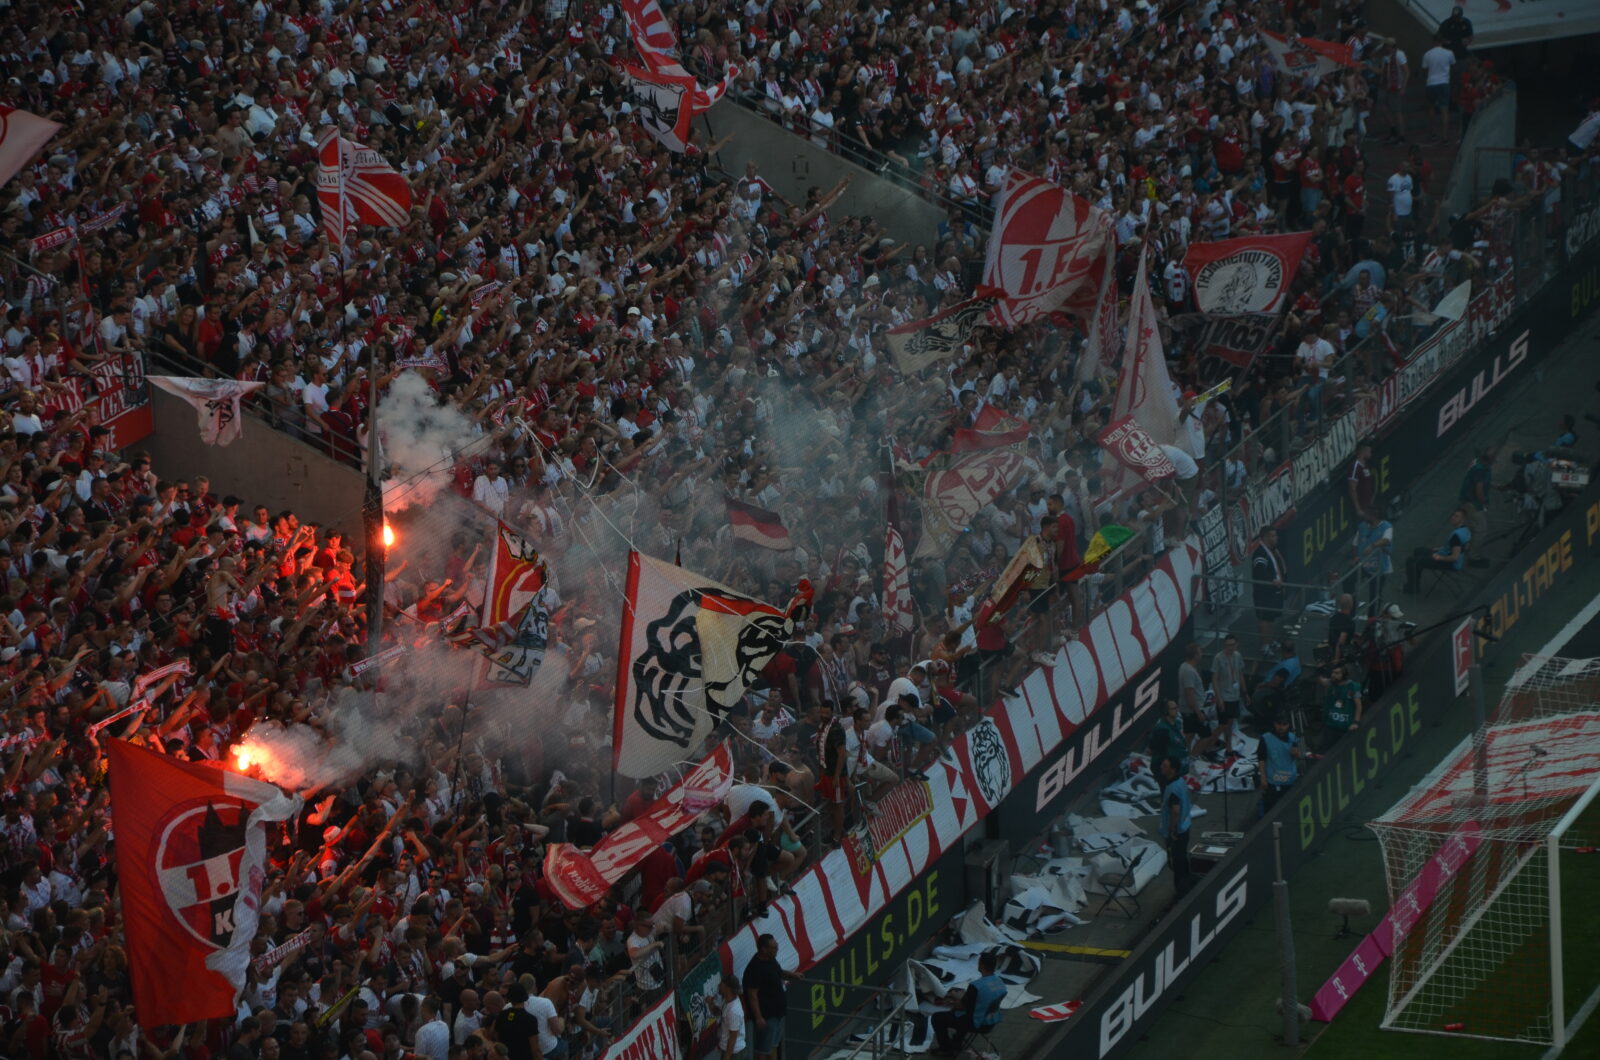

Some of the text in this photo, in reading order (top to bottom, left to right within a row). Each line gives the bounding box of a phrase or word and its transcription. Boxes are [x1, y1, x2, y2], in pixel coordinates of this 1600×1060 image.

[1437, 329, 1530, 438] BULLS
[1002, 533, 1203, 776] HORDE
[1036, 667, 1160, 813] BULLS
[1299, 683, 1422, 850] BULLS.DE
[811, 869, 940, 1030] BULLS.DE
[1099, 864, 1248, 1058] BULLS
